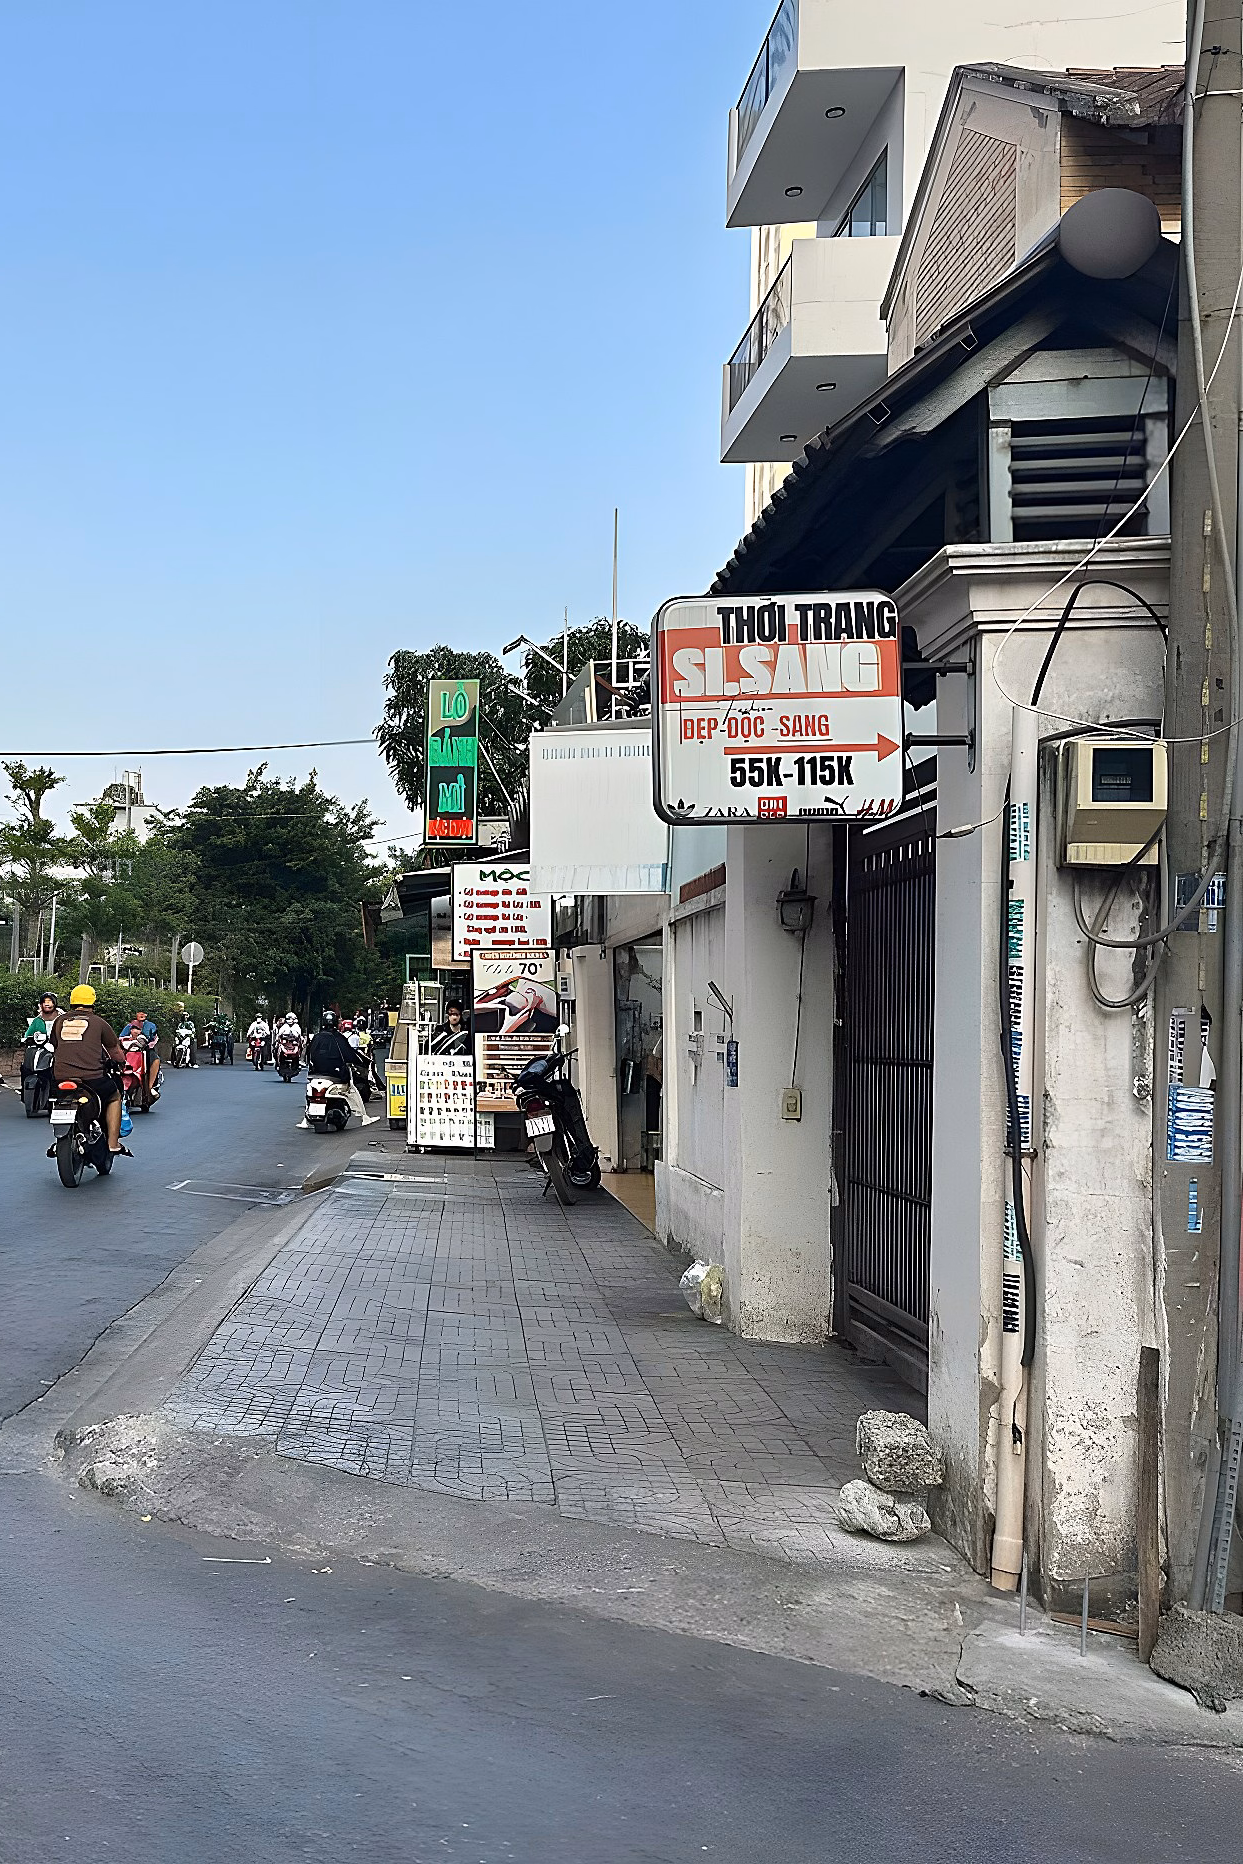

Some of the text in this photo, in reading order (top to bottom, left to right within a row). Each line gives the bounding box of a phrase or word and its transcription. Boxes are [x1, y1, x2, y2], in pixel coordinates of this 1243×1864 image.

[795, 601, 897, 641] TRANG
[673, 643, 881, 696] SI.SANG
[730, 756, 854, 787] 55K-115K
